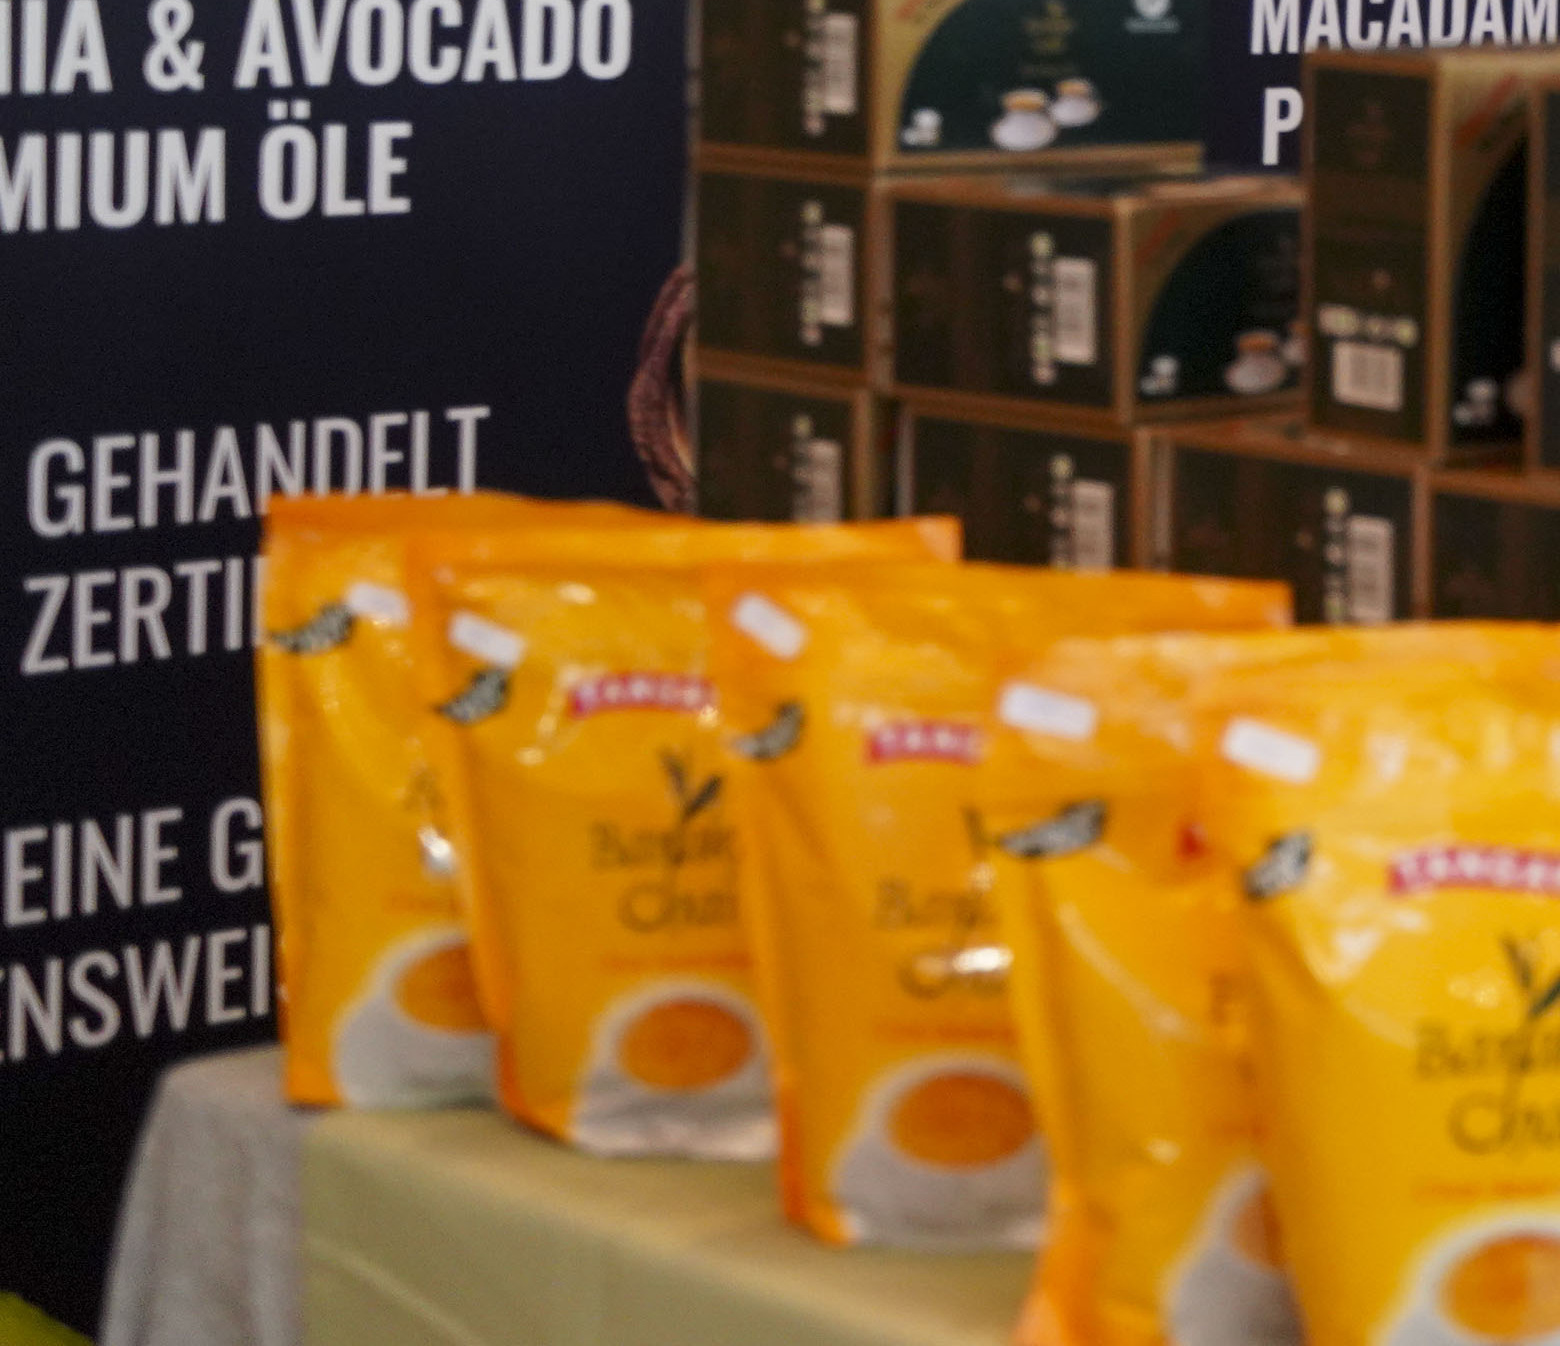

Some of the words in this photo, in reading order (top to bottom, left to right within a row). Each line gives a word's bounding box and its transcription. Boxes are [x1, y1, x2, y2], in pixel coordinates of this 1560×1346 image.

[258, 101, 412, 220] ÖLE
[29, 406, 491, 538] GEHANDELT
[4, 809, 182, 927] EINE
